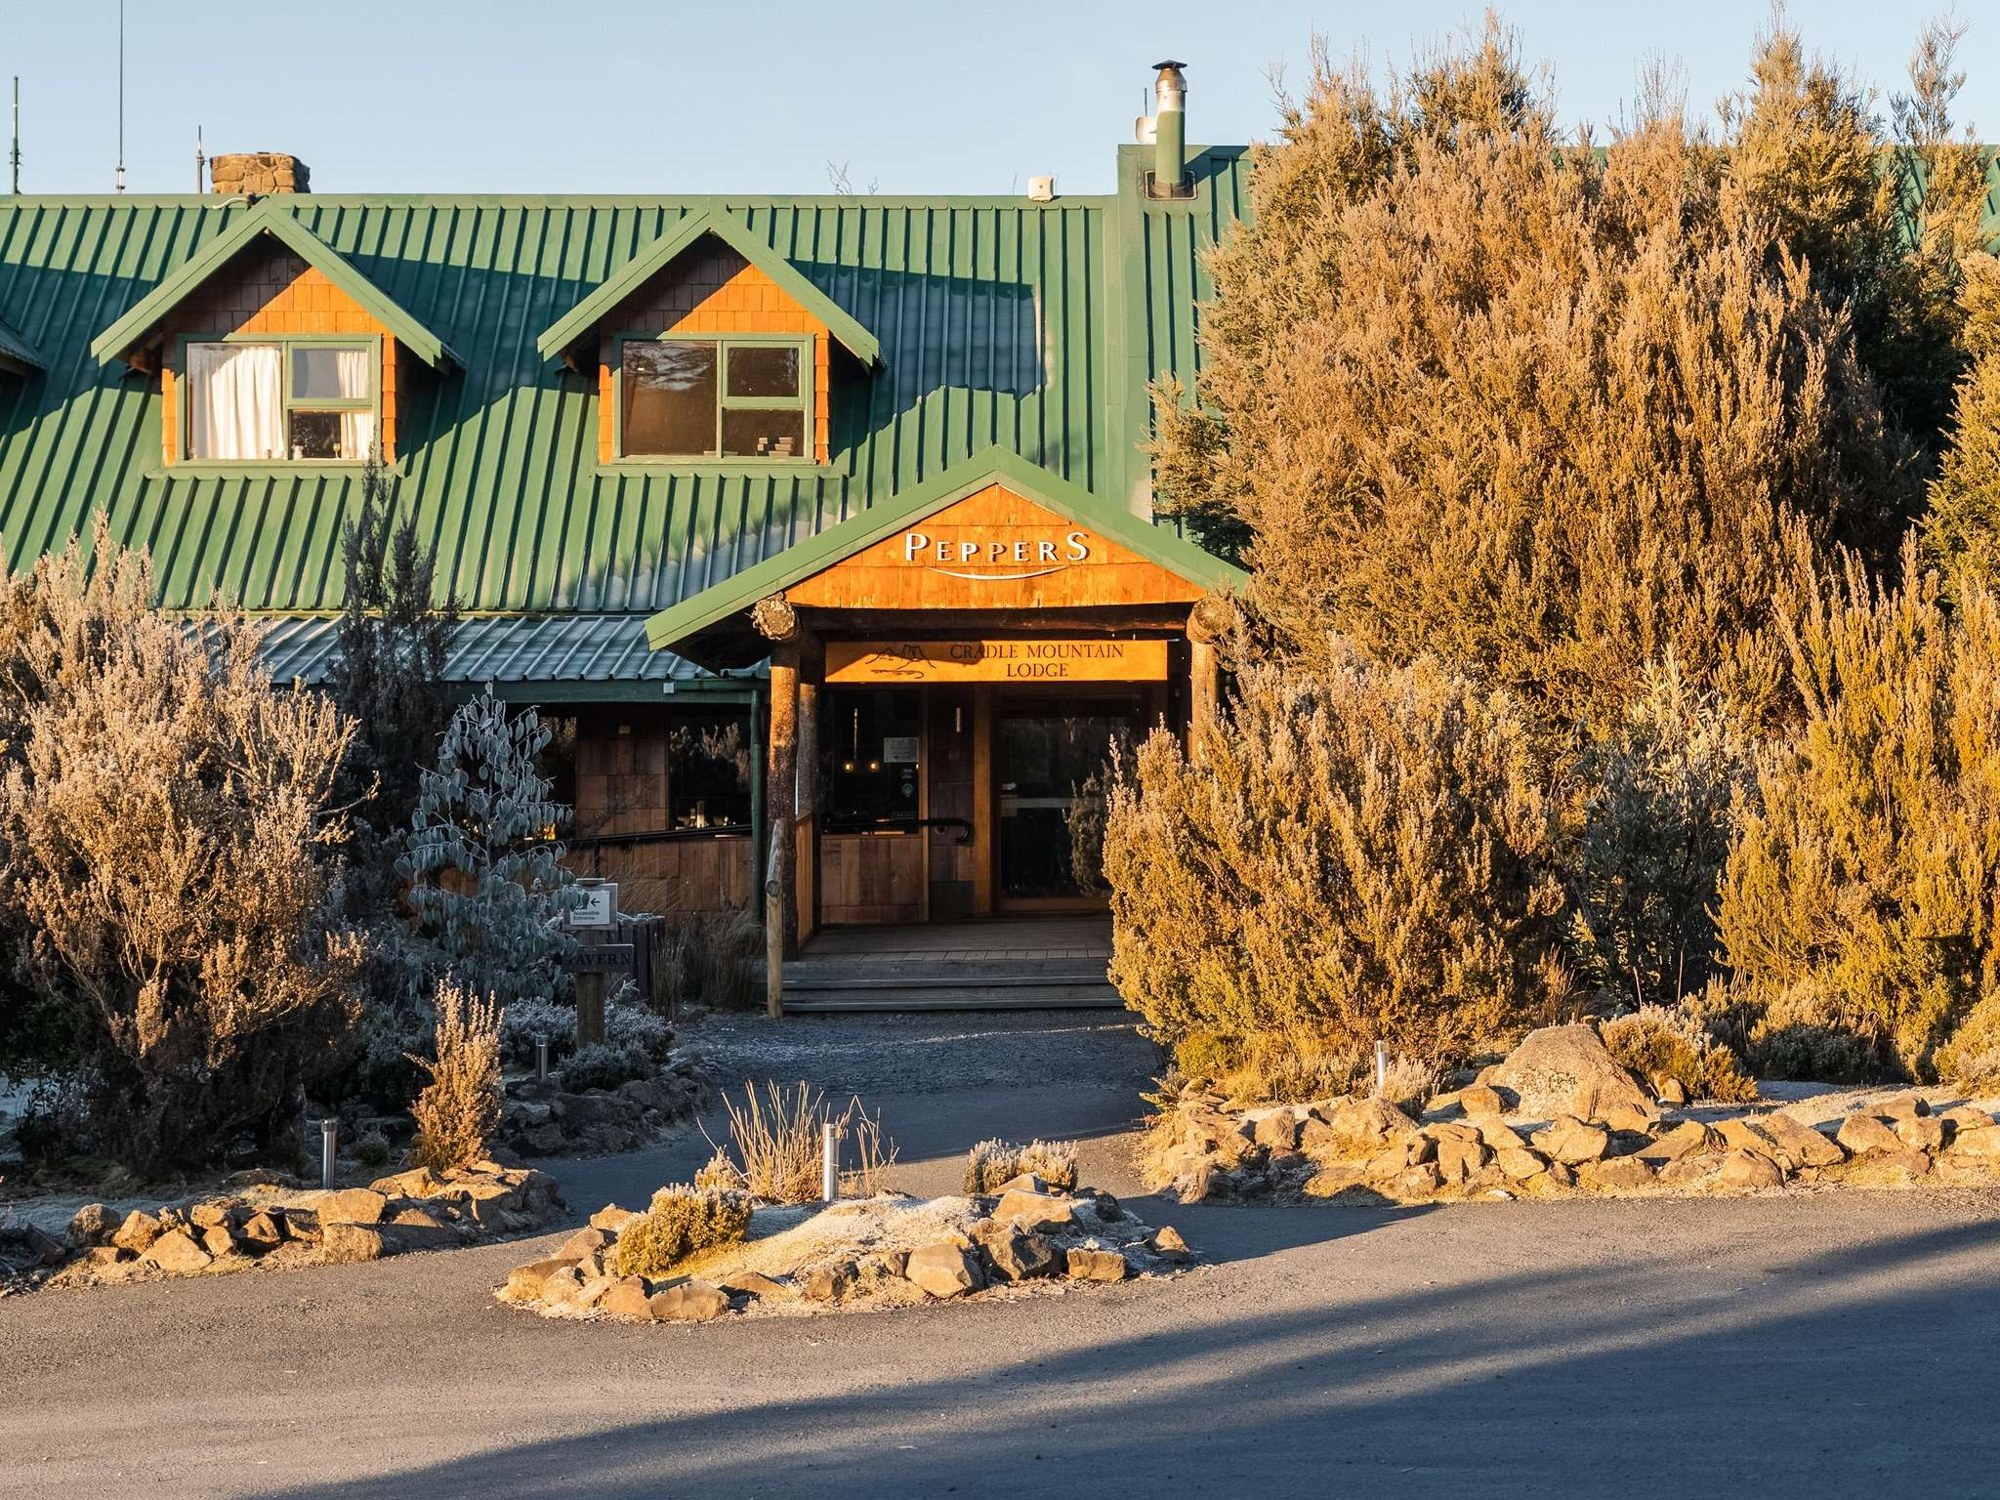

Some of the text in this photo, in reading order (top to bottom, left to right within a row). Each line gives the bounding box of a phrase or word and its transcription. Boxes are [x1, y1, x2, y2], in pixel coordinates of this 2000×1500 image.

[905, 532, 1088, 562] PEPPERS
[950, 643, 1124, 659] CRADLE MOUNTAIN
[1007, 662, 1068, 678] LODGE
